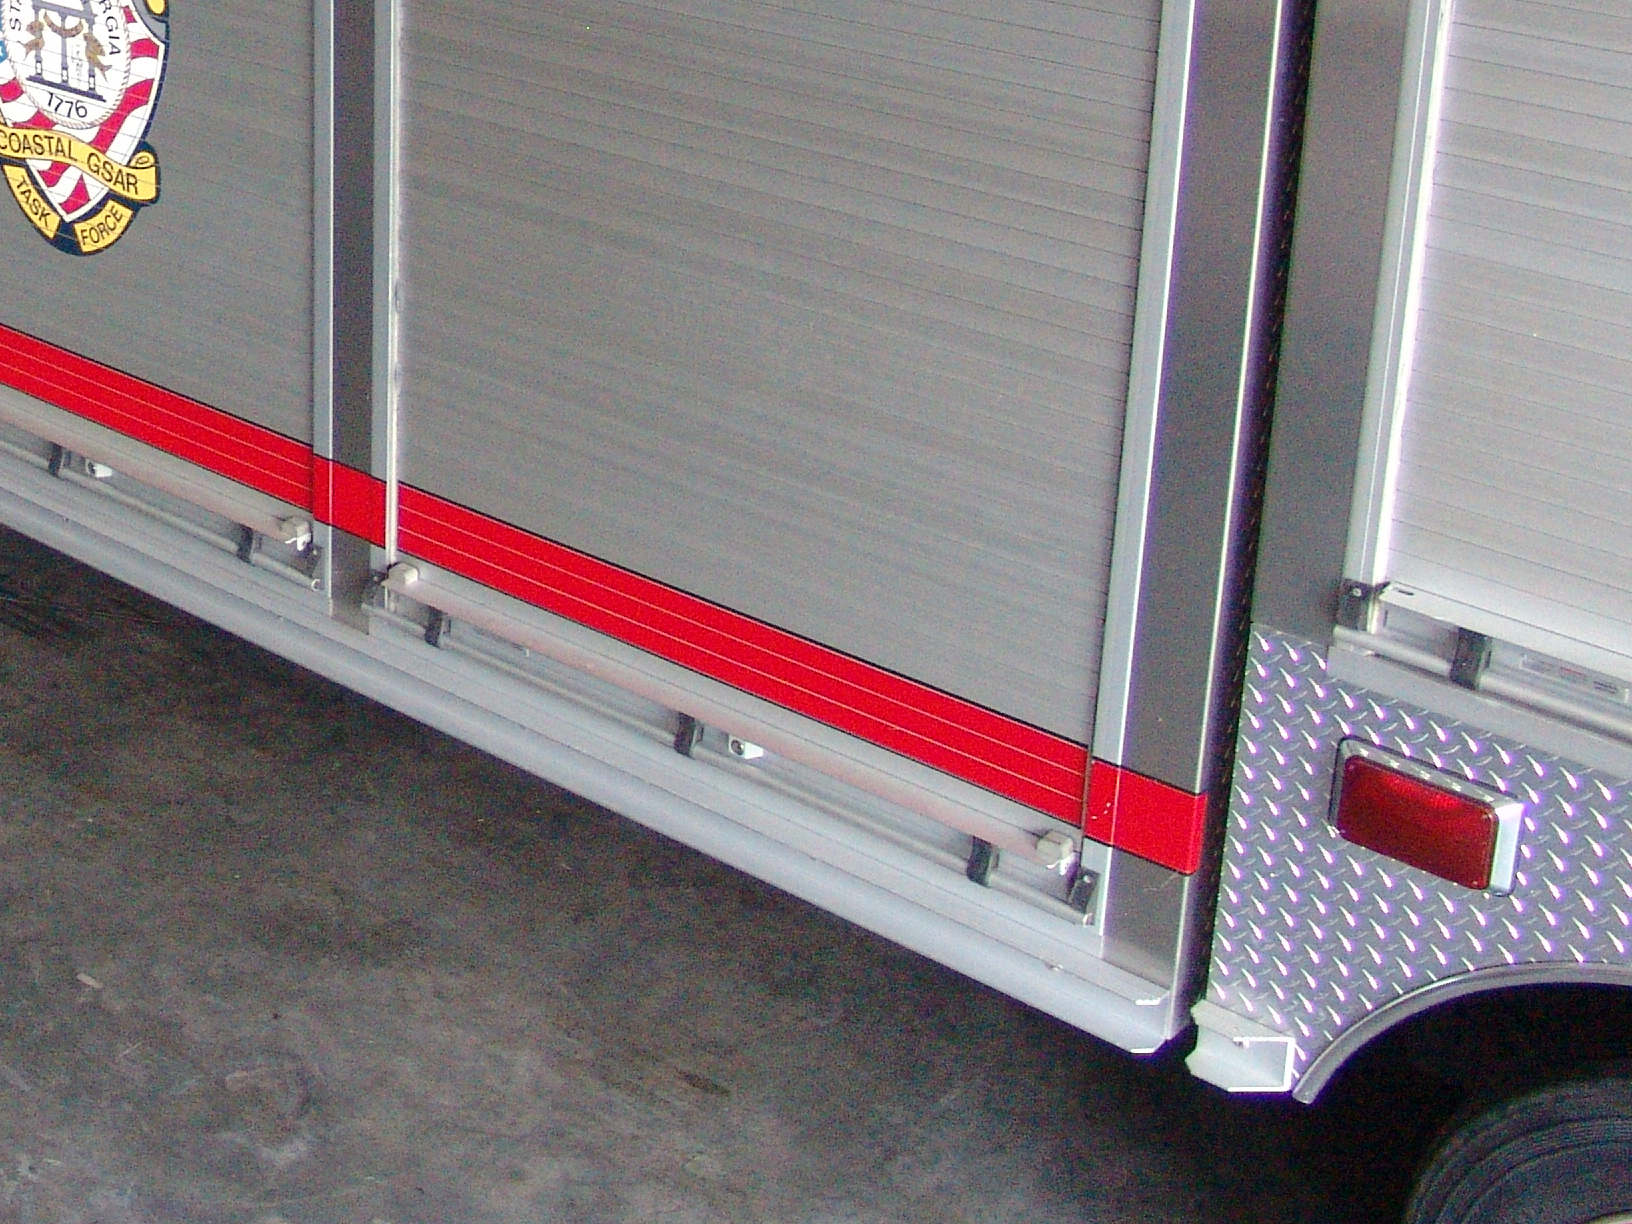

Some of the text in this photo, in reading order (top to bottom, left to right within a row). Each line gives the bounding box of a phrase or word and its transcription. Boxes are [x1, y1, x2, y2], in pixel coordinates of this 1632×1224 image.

[46, 92, 88, 118] 1776
[87, 152, 139, 196] GSAR
[16, 175, 123, 246] TASK FORCE
